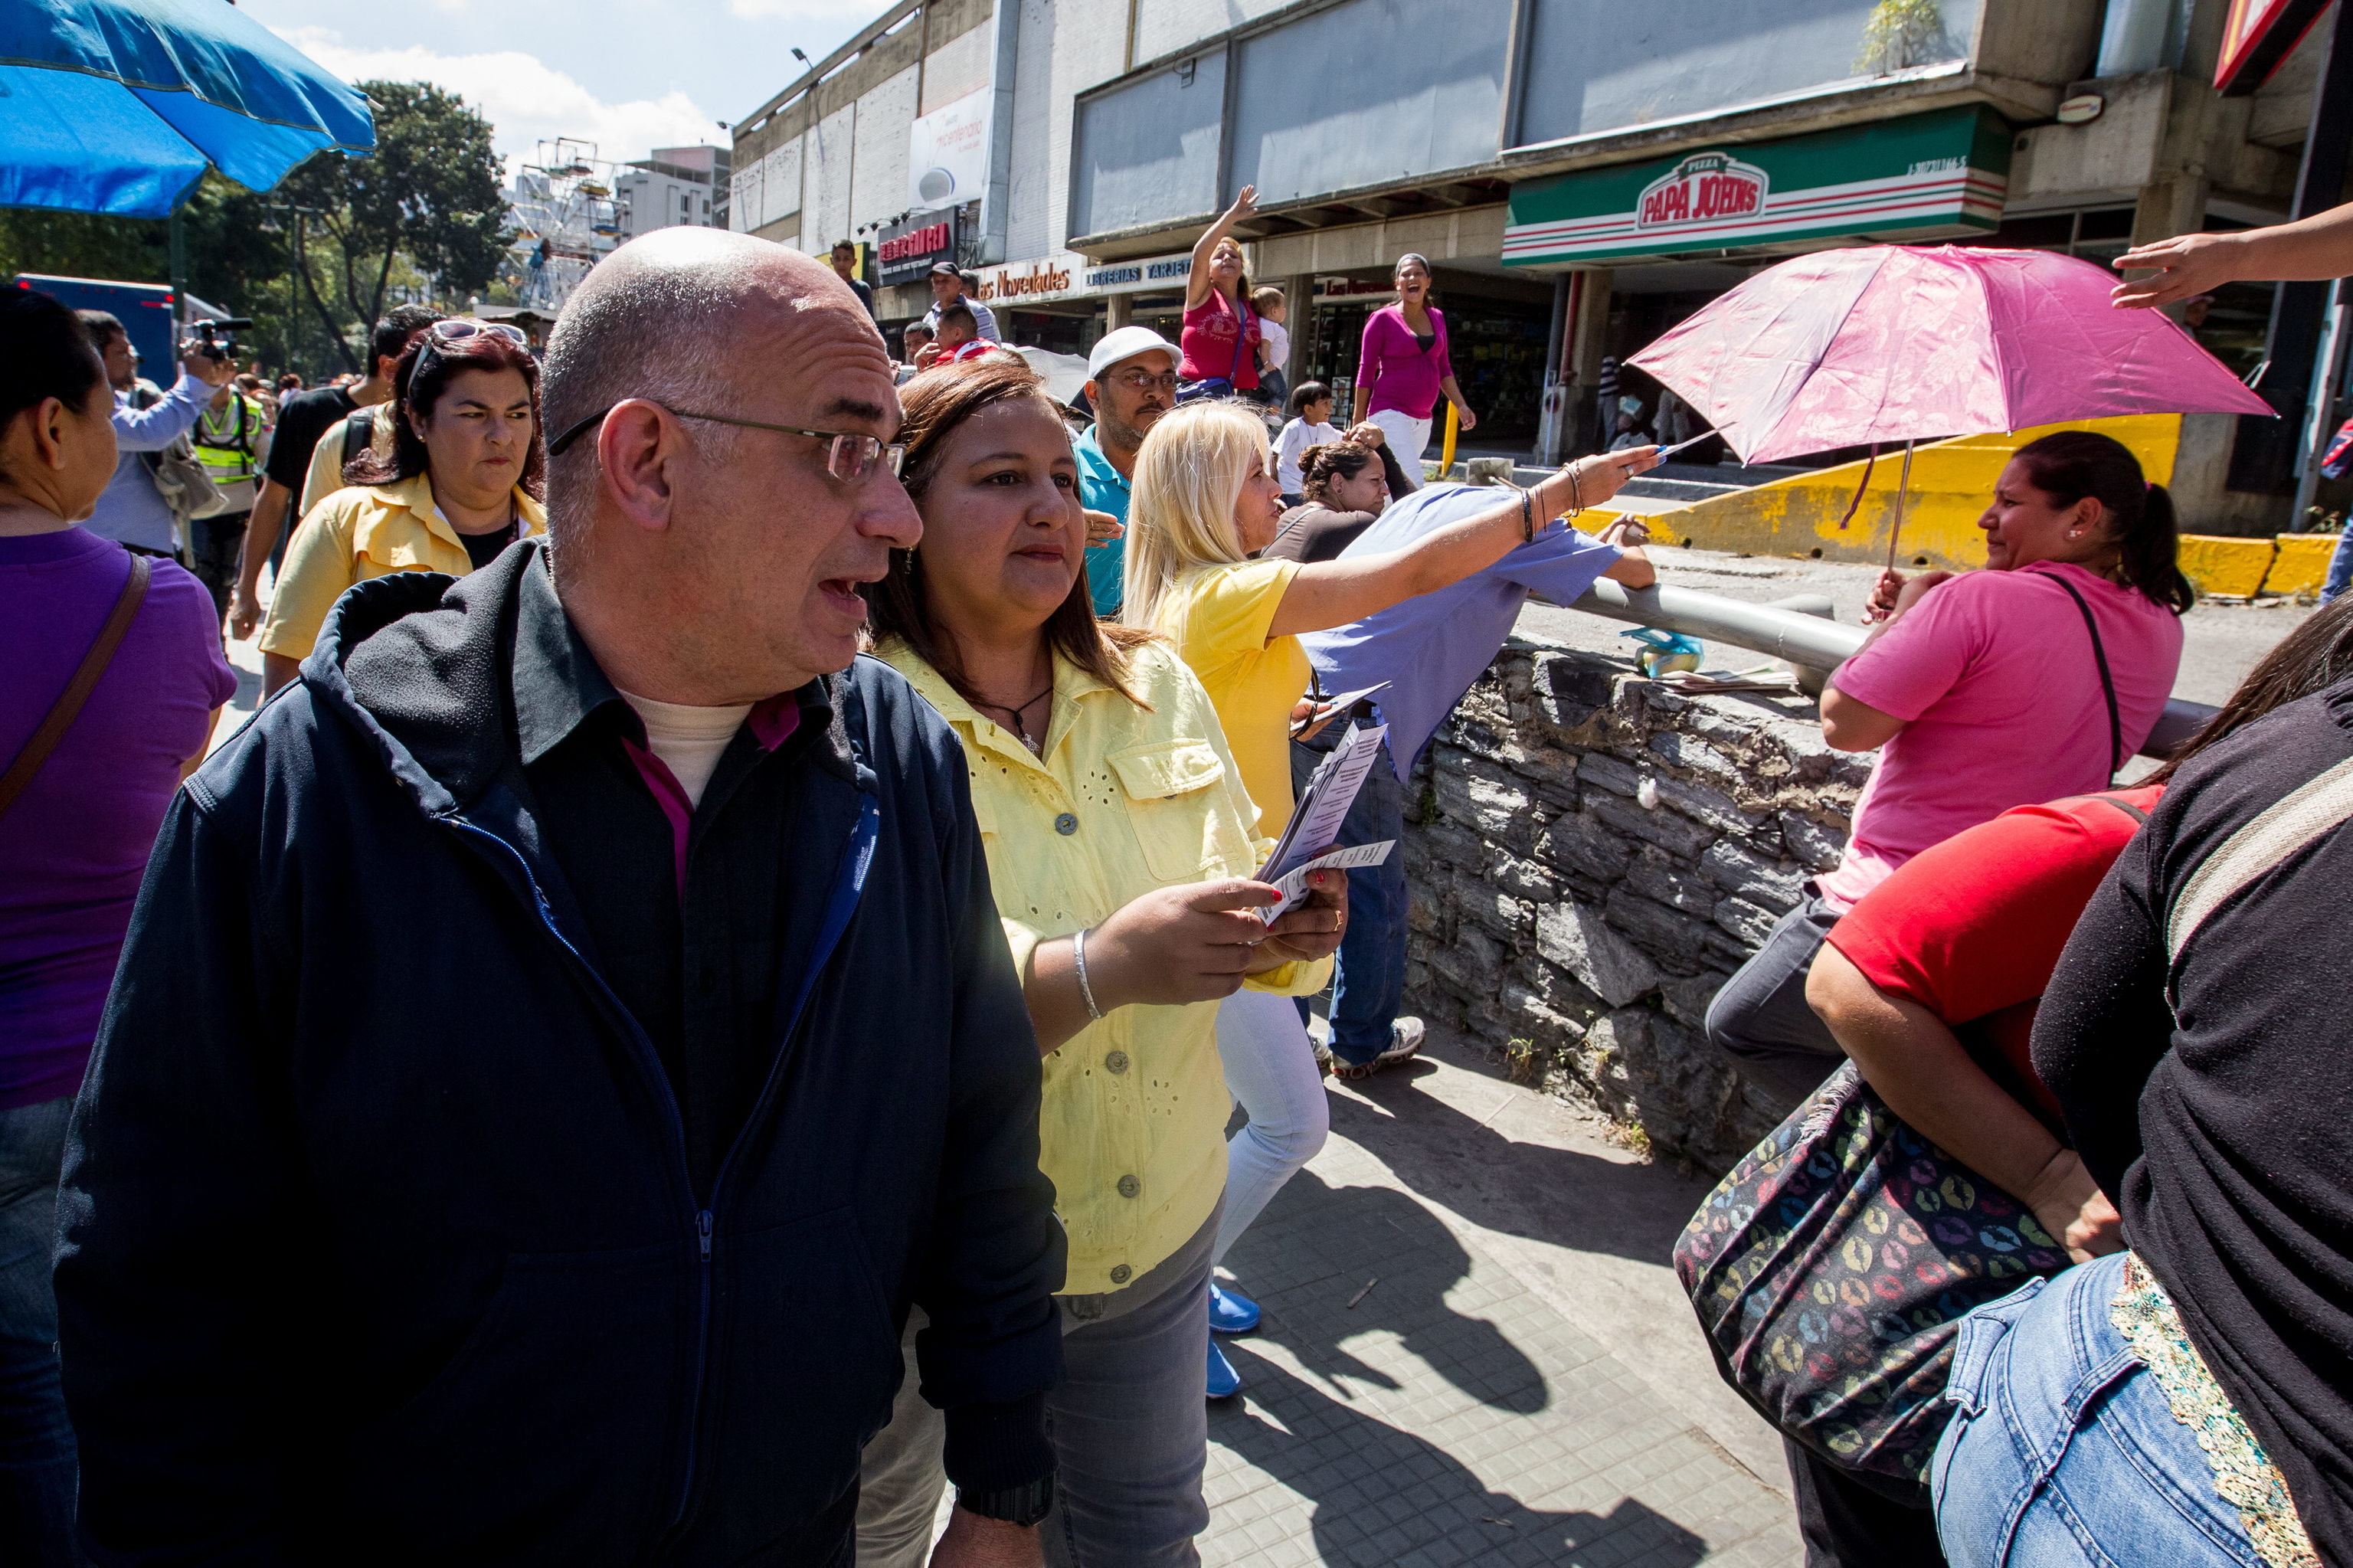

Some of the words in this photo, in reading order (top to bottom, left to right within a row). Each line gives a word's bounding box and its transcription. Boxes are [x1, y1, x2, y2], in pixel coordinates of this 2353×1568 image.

[1687, 158, 1719, 172] PIZZA
[1643, 181, 1690, 223] PAPA
[997, 262, 1070, 297] Novedades
[1086, 267, 1141, 286] LIBRERIAS
[1147, 260, 1193, 280] TARJET
